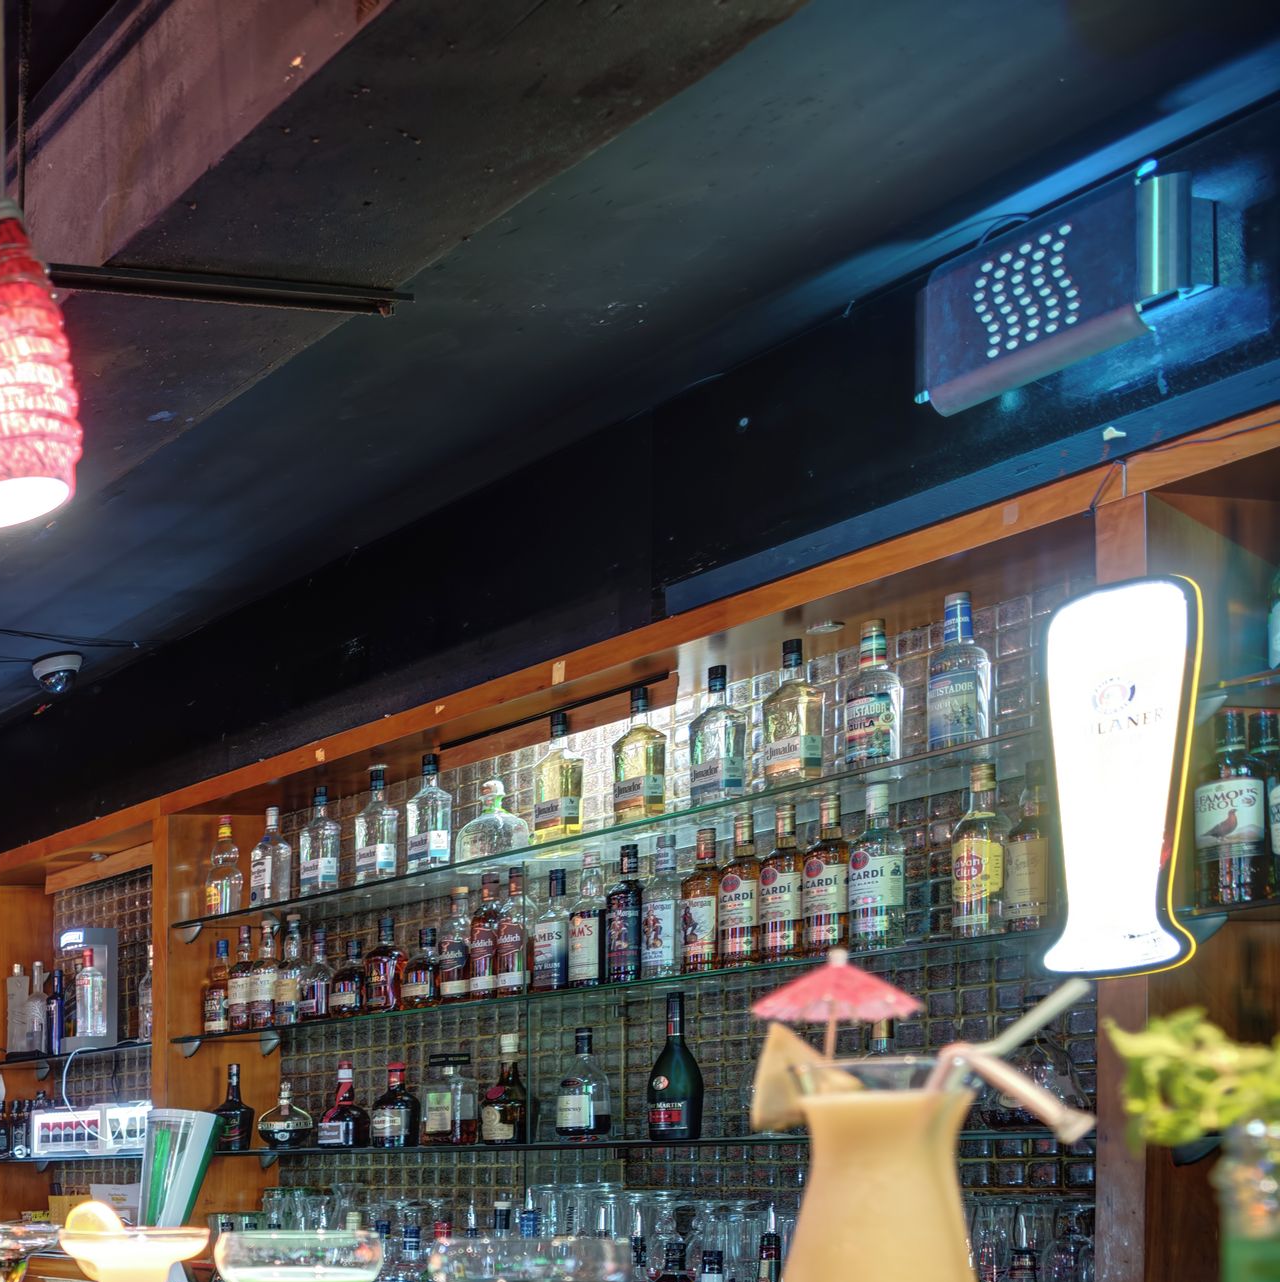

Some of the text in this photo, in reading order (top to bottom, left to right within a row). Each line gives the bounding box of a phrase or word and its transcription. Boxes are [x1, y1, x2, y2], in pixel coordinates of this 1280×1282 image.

[767, 743, 800, 761] Jimador
[691, 764, 719, 783] Jimador
[616, 781, 642, 799] Jimador
[953, 856, 989, 869] avana
[849, 866, 885, 881] CARDÍ
[719, 889, 754, 903] CARDÍ
[761, 883, 792, 897] CARDÍ
[534, 931, 562, 943] AMB'S
